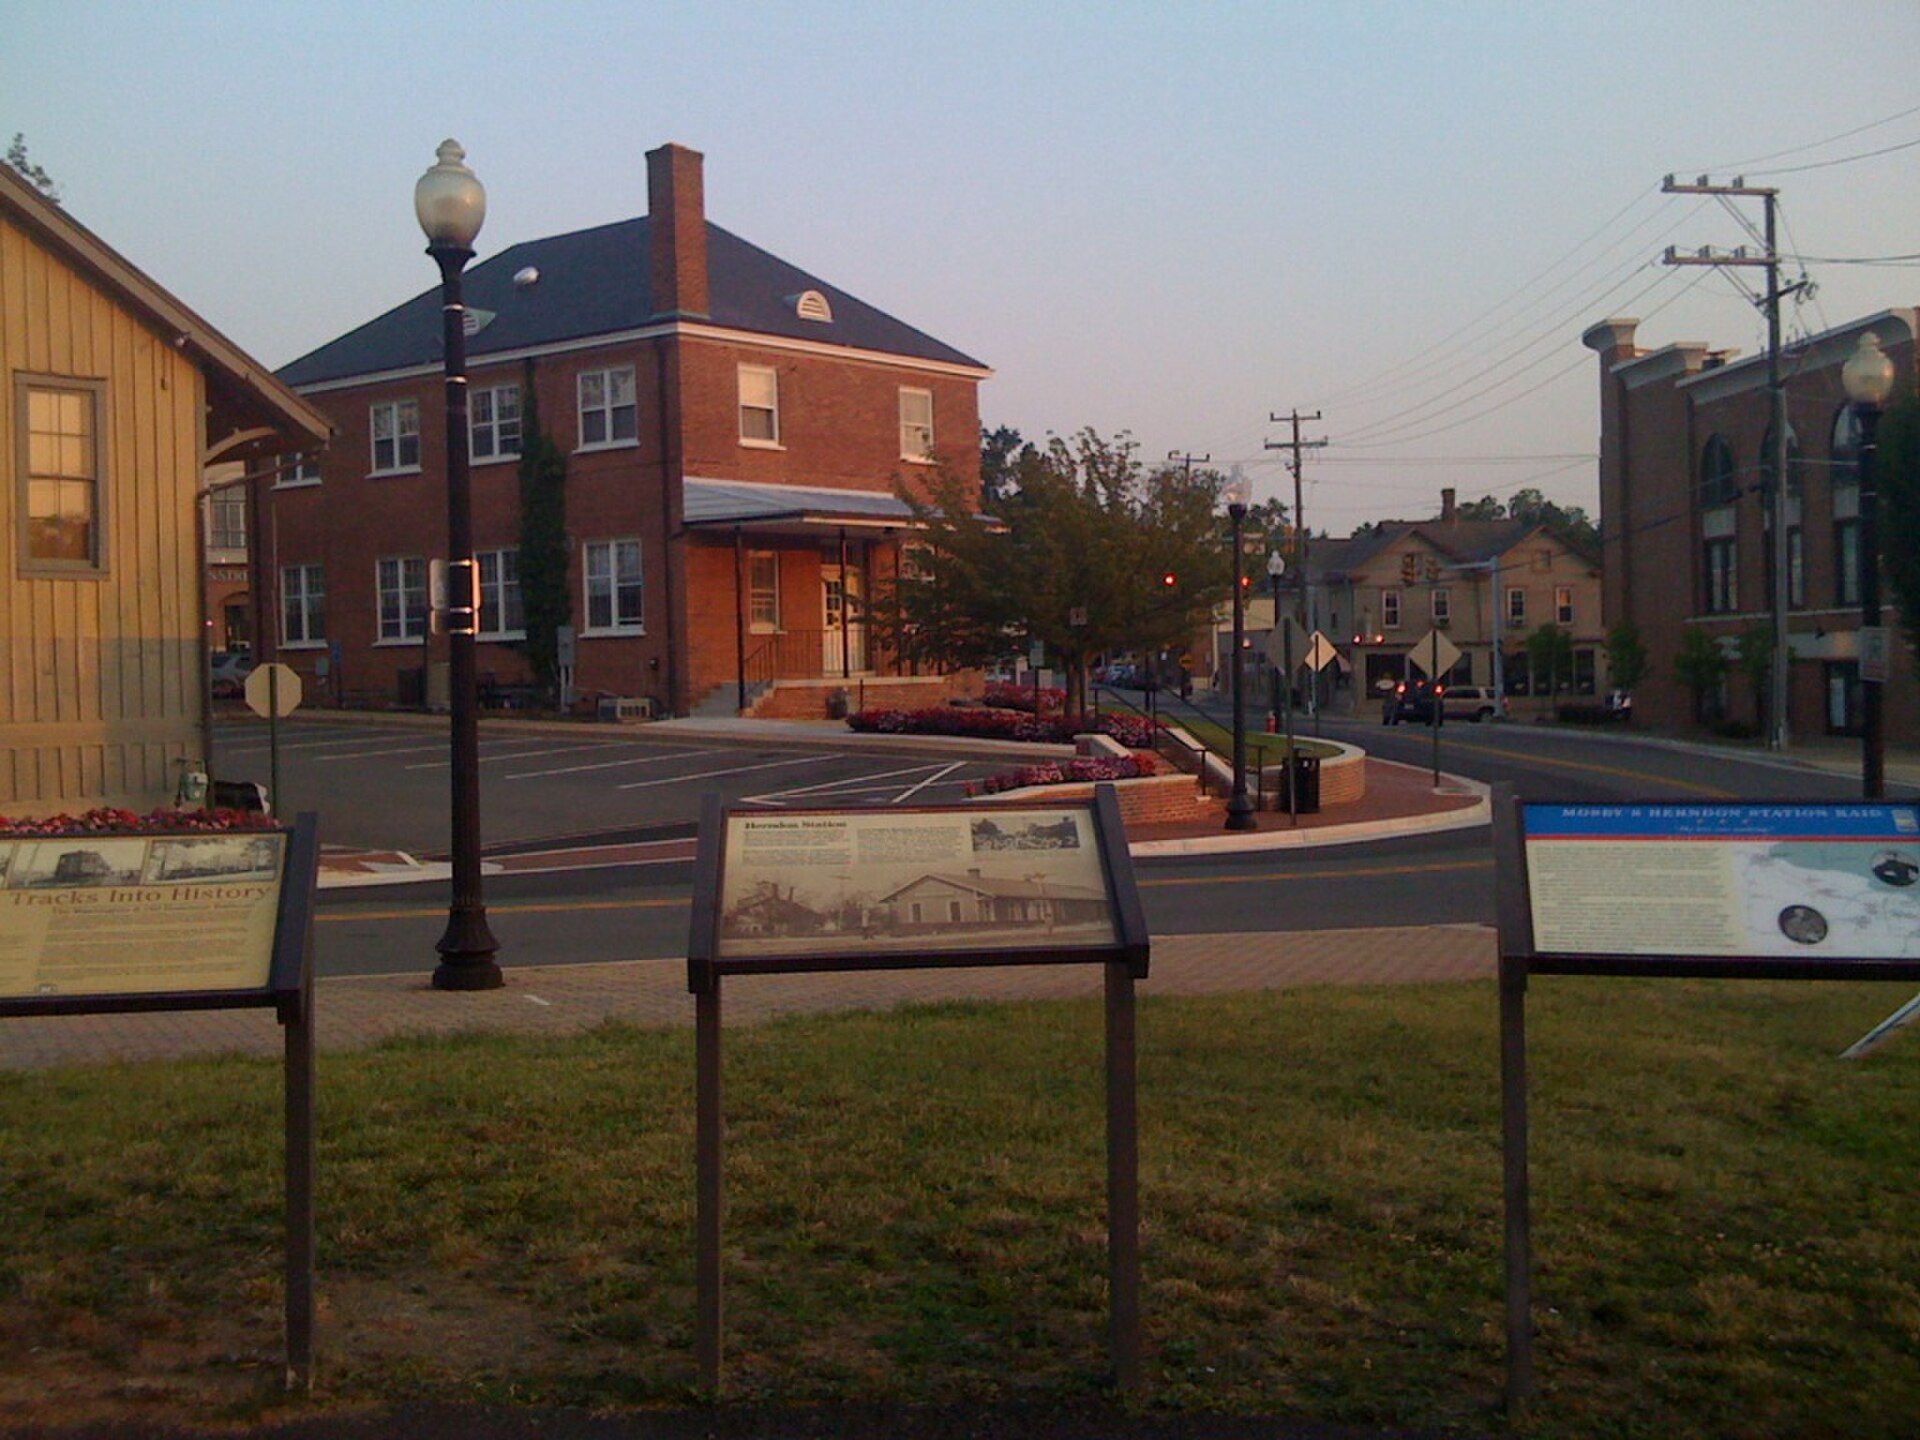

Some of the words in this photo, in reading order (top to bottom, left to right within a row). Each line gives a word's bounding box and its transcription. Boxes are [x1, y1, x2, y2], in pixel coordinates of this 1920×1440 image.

[1835, 808, 1883, 818] RAID
[13, 889, 99, 906] Tracks
[109, 888, 161, 903] Into
[171, 885, 272, 902] History
